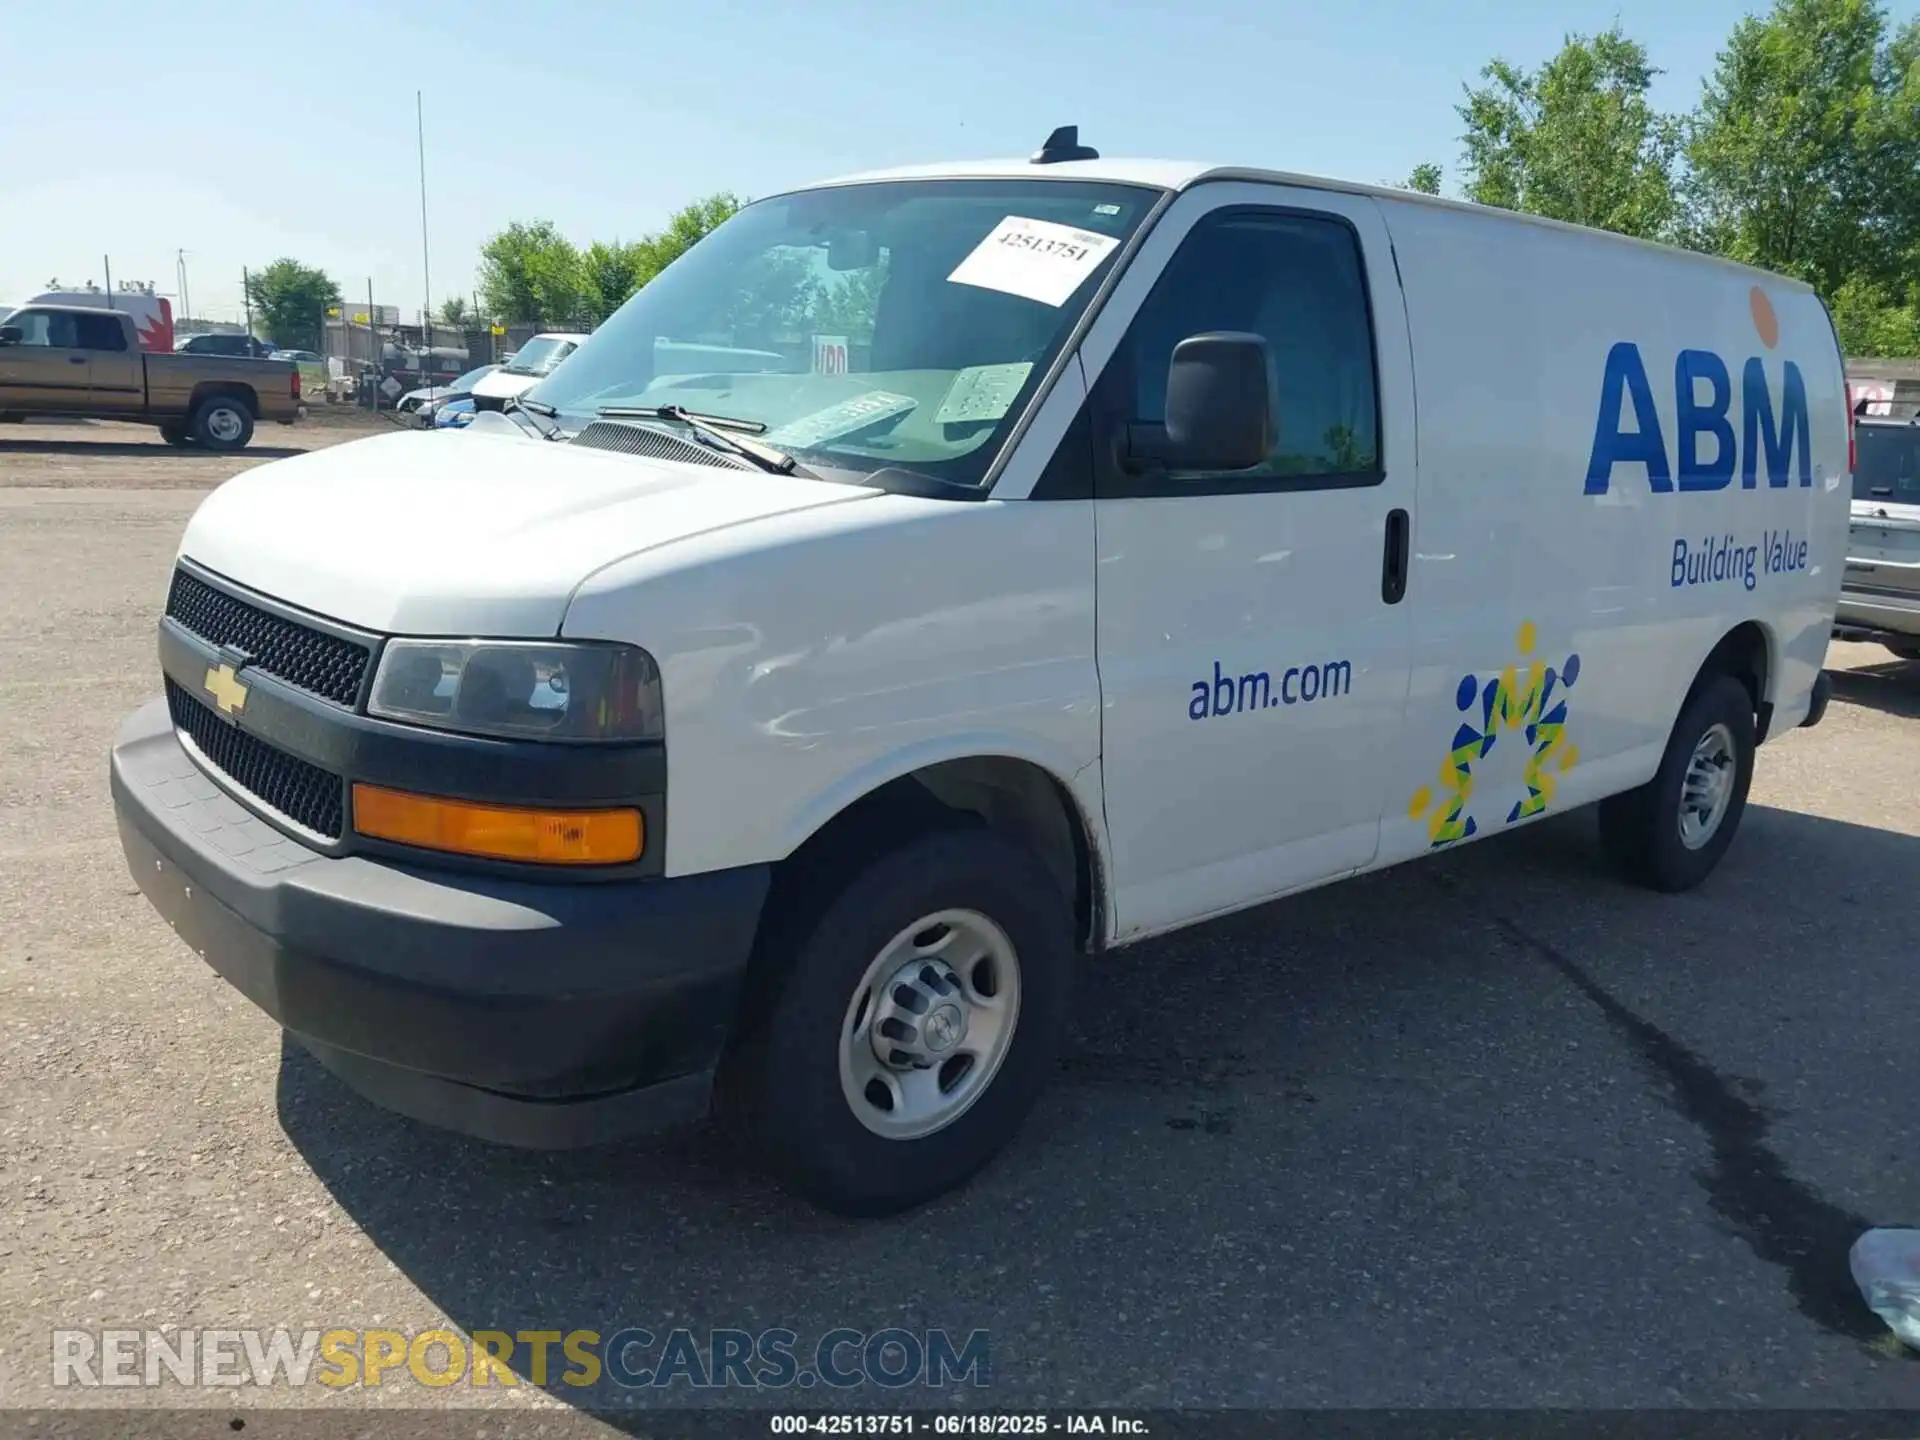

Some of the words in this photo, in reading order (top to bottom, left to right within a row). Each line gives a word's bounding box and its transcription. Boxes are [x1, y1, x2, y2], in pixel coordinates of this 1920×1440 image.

[997, 231, 1090, 262] 42513751
[1583, 341, 1811, 496] ABM
[1671, 535, 1757, 591] Building
[1763, 529, 1808, 576] Value
[1188, 660, 1351, 720] abm.com
